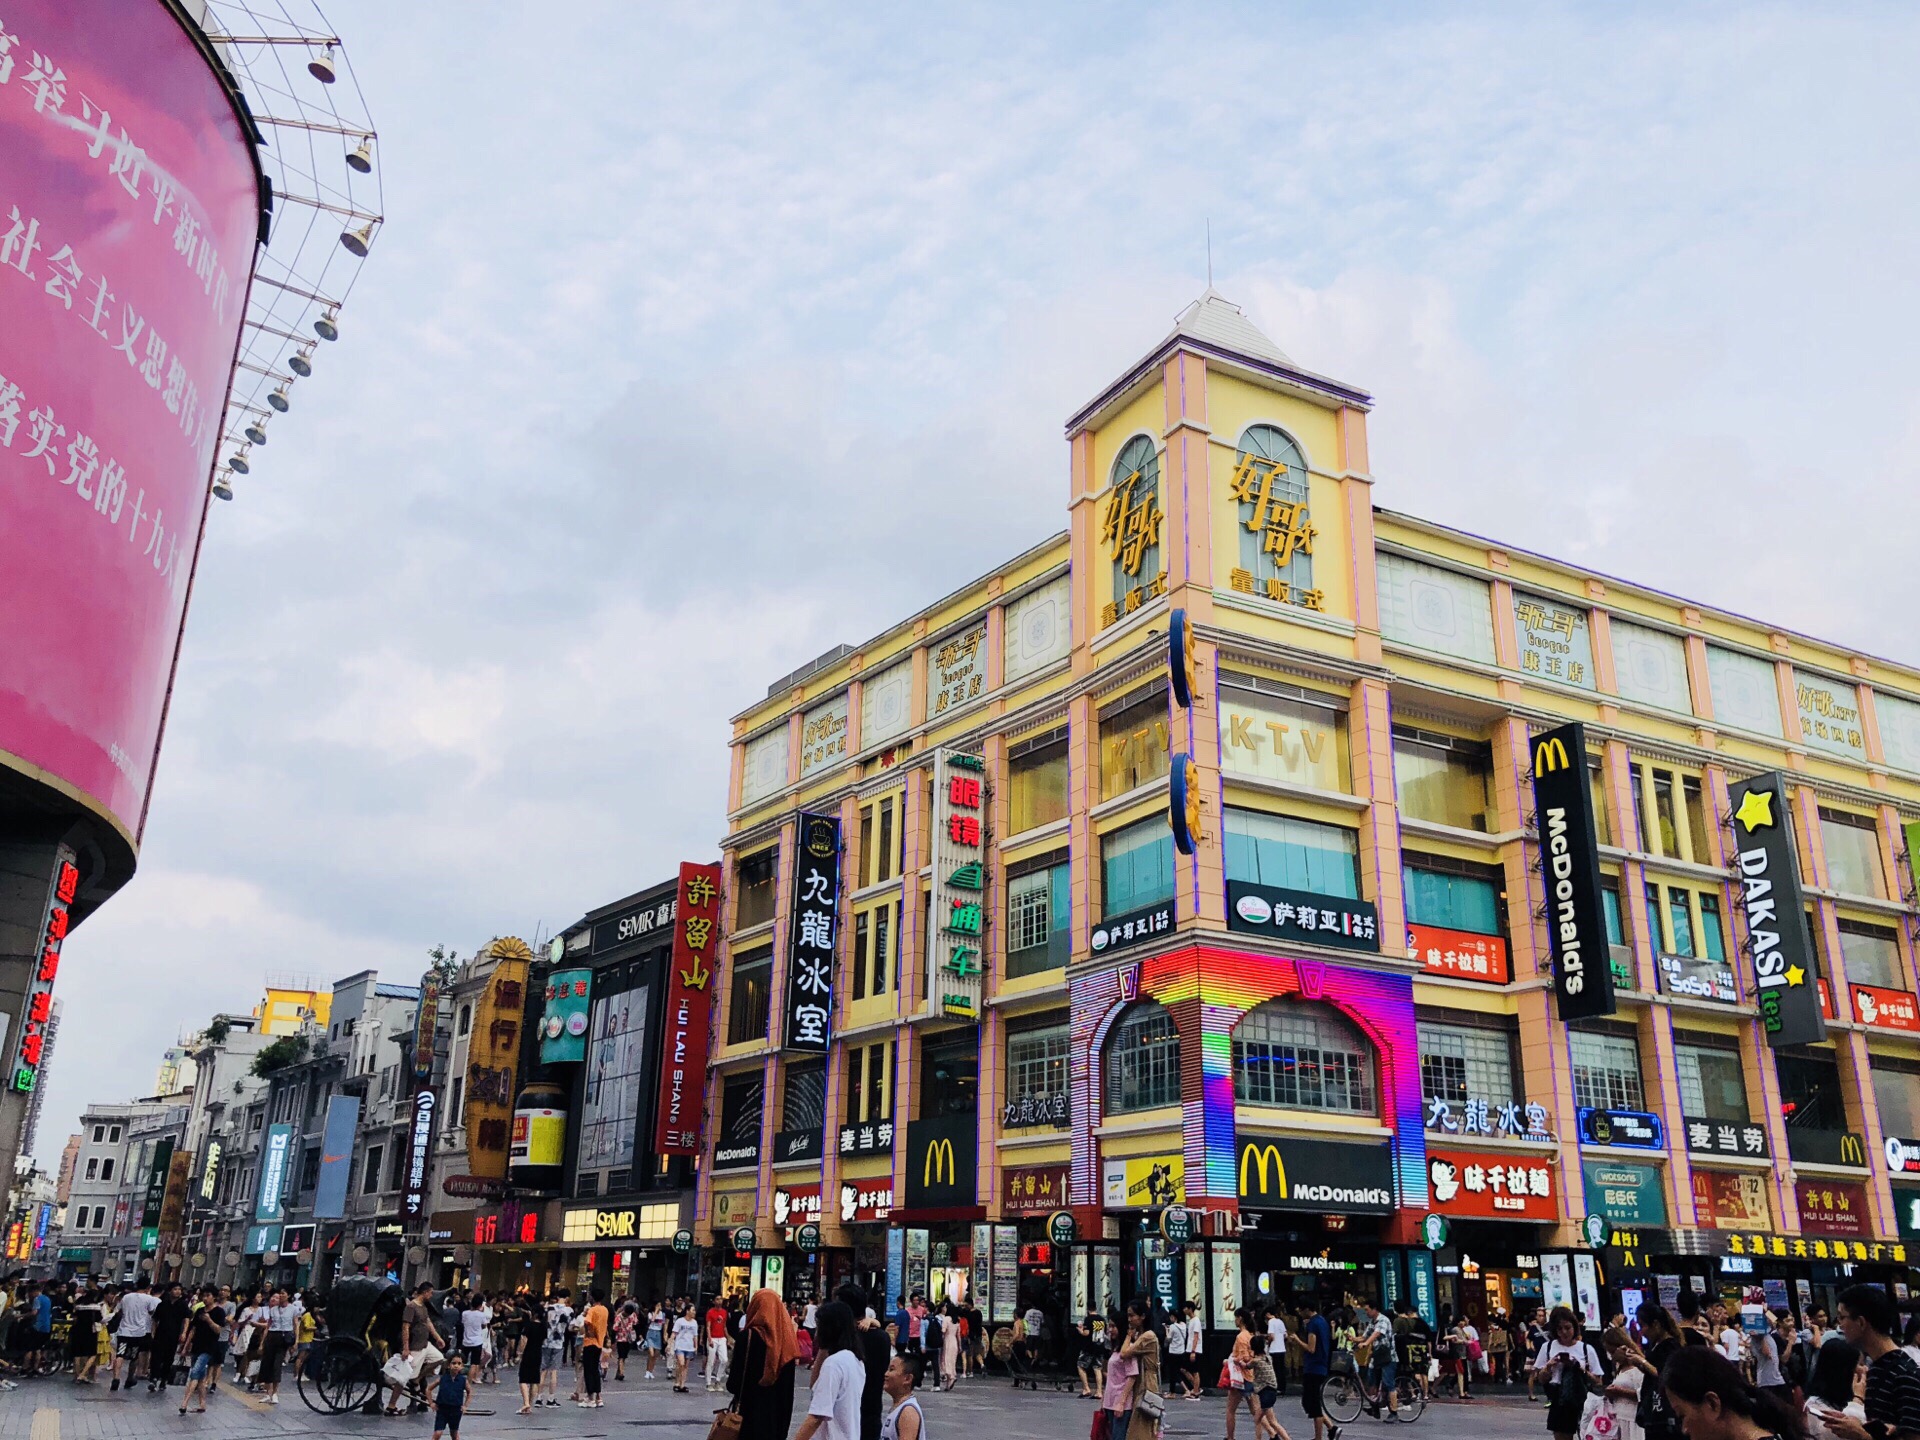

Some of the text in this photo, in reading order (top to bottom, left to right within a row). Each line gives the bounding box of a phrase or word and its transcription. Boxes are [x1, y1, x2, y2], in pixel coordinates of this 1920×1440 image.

[1100, 470, 1163, 577] 好歌
[1228, 453, 1319, 567] 好歌
[1100, 571, 1168, 630] 量贩式
[1231, 567, 1325, 613] 量贩式
[1523, 649, 1583, 683] 康王店
[935, 674, 982, 714] 康王店
[1833, 705, 1857, 723] KTV
[1111, 722, 1170, 776] KTV
[1230, 713, 1325, 763] KTV
[1547, 807, 1584, 995] McDonald's
[618, 909, 655, 940] SEMIR
[680, 875, 716, 990] 許留山
[1110, 918, 1148, 945] 萨莉亚
[1274, 902, 1341, 933] 萨莉亚
[1352, 914, 1374, 928] 意式
[1352, 926, 1375, 940] 餐厅
[1740, 847, 1788, 988] DAKASI
[795, 868, 832, 1044] 九龍冰室
[677, 998, 689, 1025] HUI
[1761, 990, 1782, 1032] tea
[673, 1032, 687, 1063] LAU
[1003, 1093, 1067, 1124] 九龍冰室
[1426, 1095, 1549, 1135] 九龍冰室
[665, 1130, 695, 1148] 三楼
[840, 1122, 893, 1153] 麦当劳
[1689, 1122, 1764, 1153] 麦当劳
[716, 1145, 757, 1162] McDonald's
[1293, 1184, 1390, 1205] McDonald's
[1464, 1163, 1549, 1198] 味千拉麵
[1005, 1198, 1056, 1209] HUI LAU SHAN
[1605, 1189, 1638, 1206] 屈臣氏
[1806, 1189, 1849, 1211] 許留山
[596, 1210, 635, 1237] SEMIR
[1803, 1211, 1817, 1220] HUI
[1819, 1213, 1834, 1221] LAU
[1290, 1256, 1328, 1270] DAKASI
